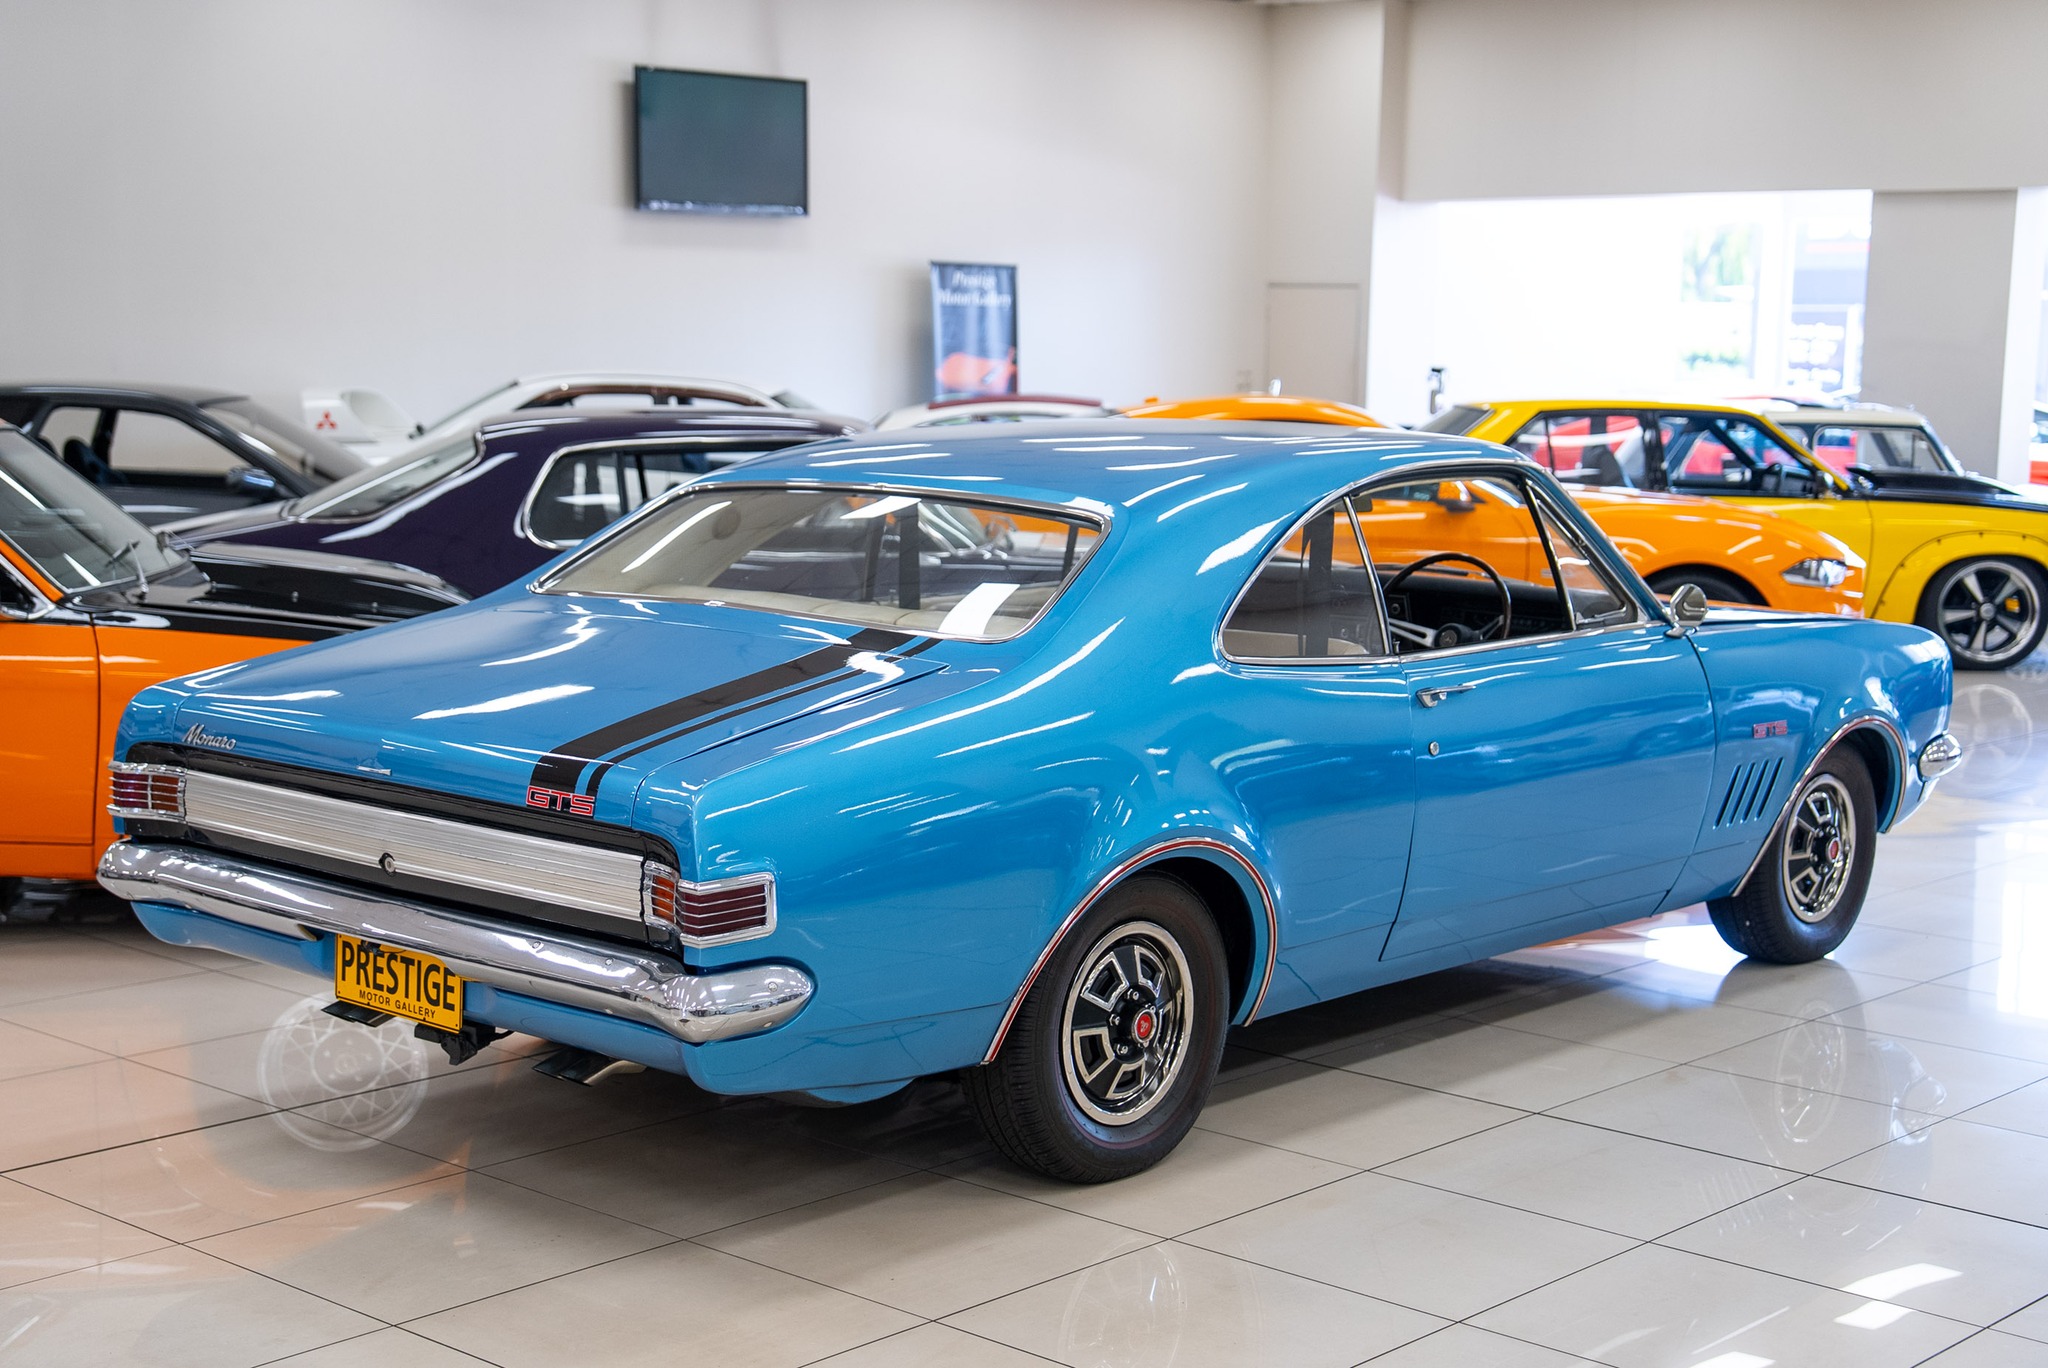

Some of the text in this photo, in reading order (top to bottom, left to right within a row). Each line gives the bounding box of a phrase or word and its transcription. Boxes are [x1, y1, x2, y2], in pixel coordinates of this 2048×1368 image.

[182, 722, 236, 750] Monaro
[1752, 719, 1788, 739] GTS
[526, 785, 595, 816] GTS
[341, 940, 456, 1012] PRESTIGE
[359, 989, 436, 1018] MOTOR GALLERY
